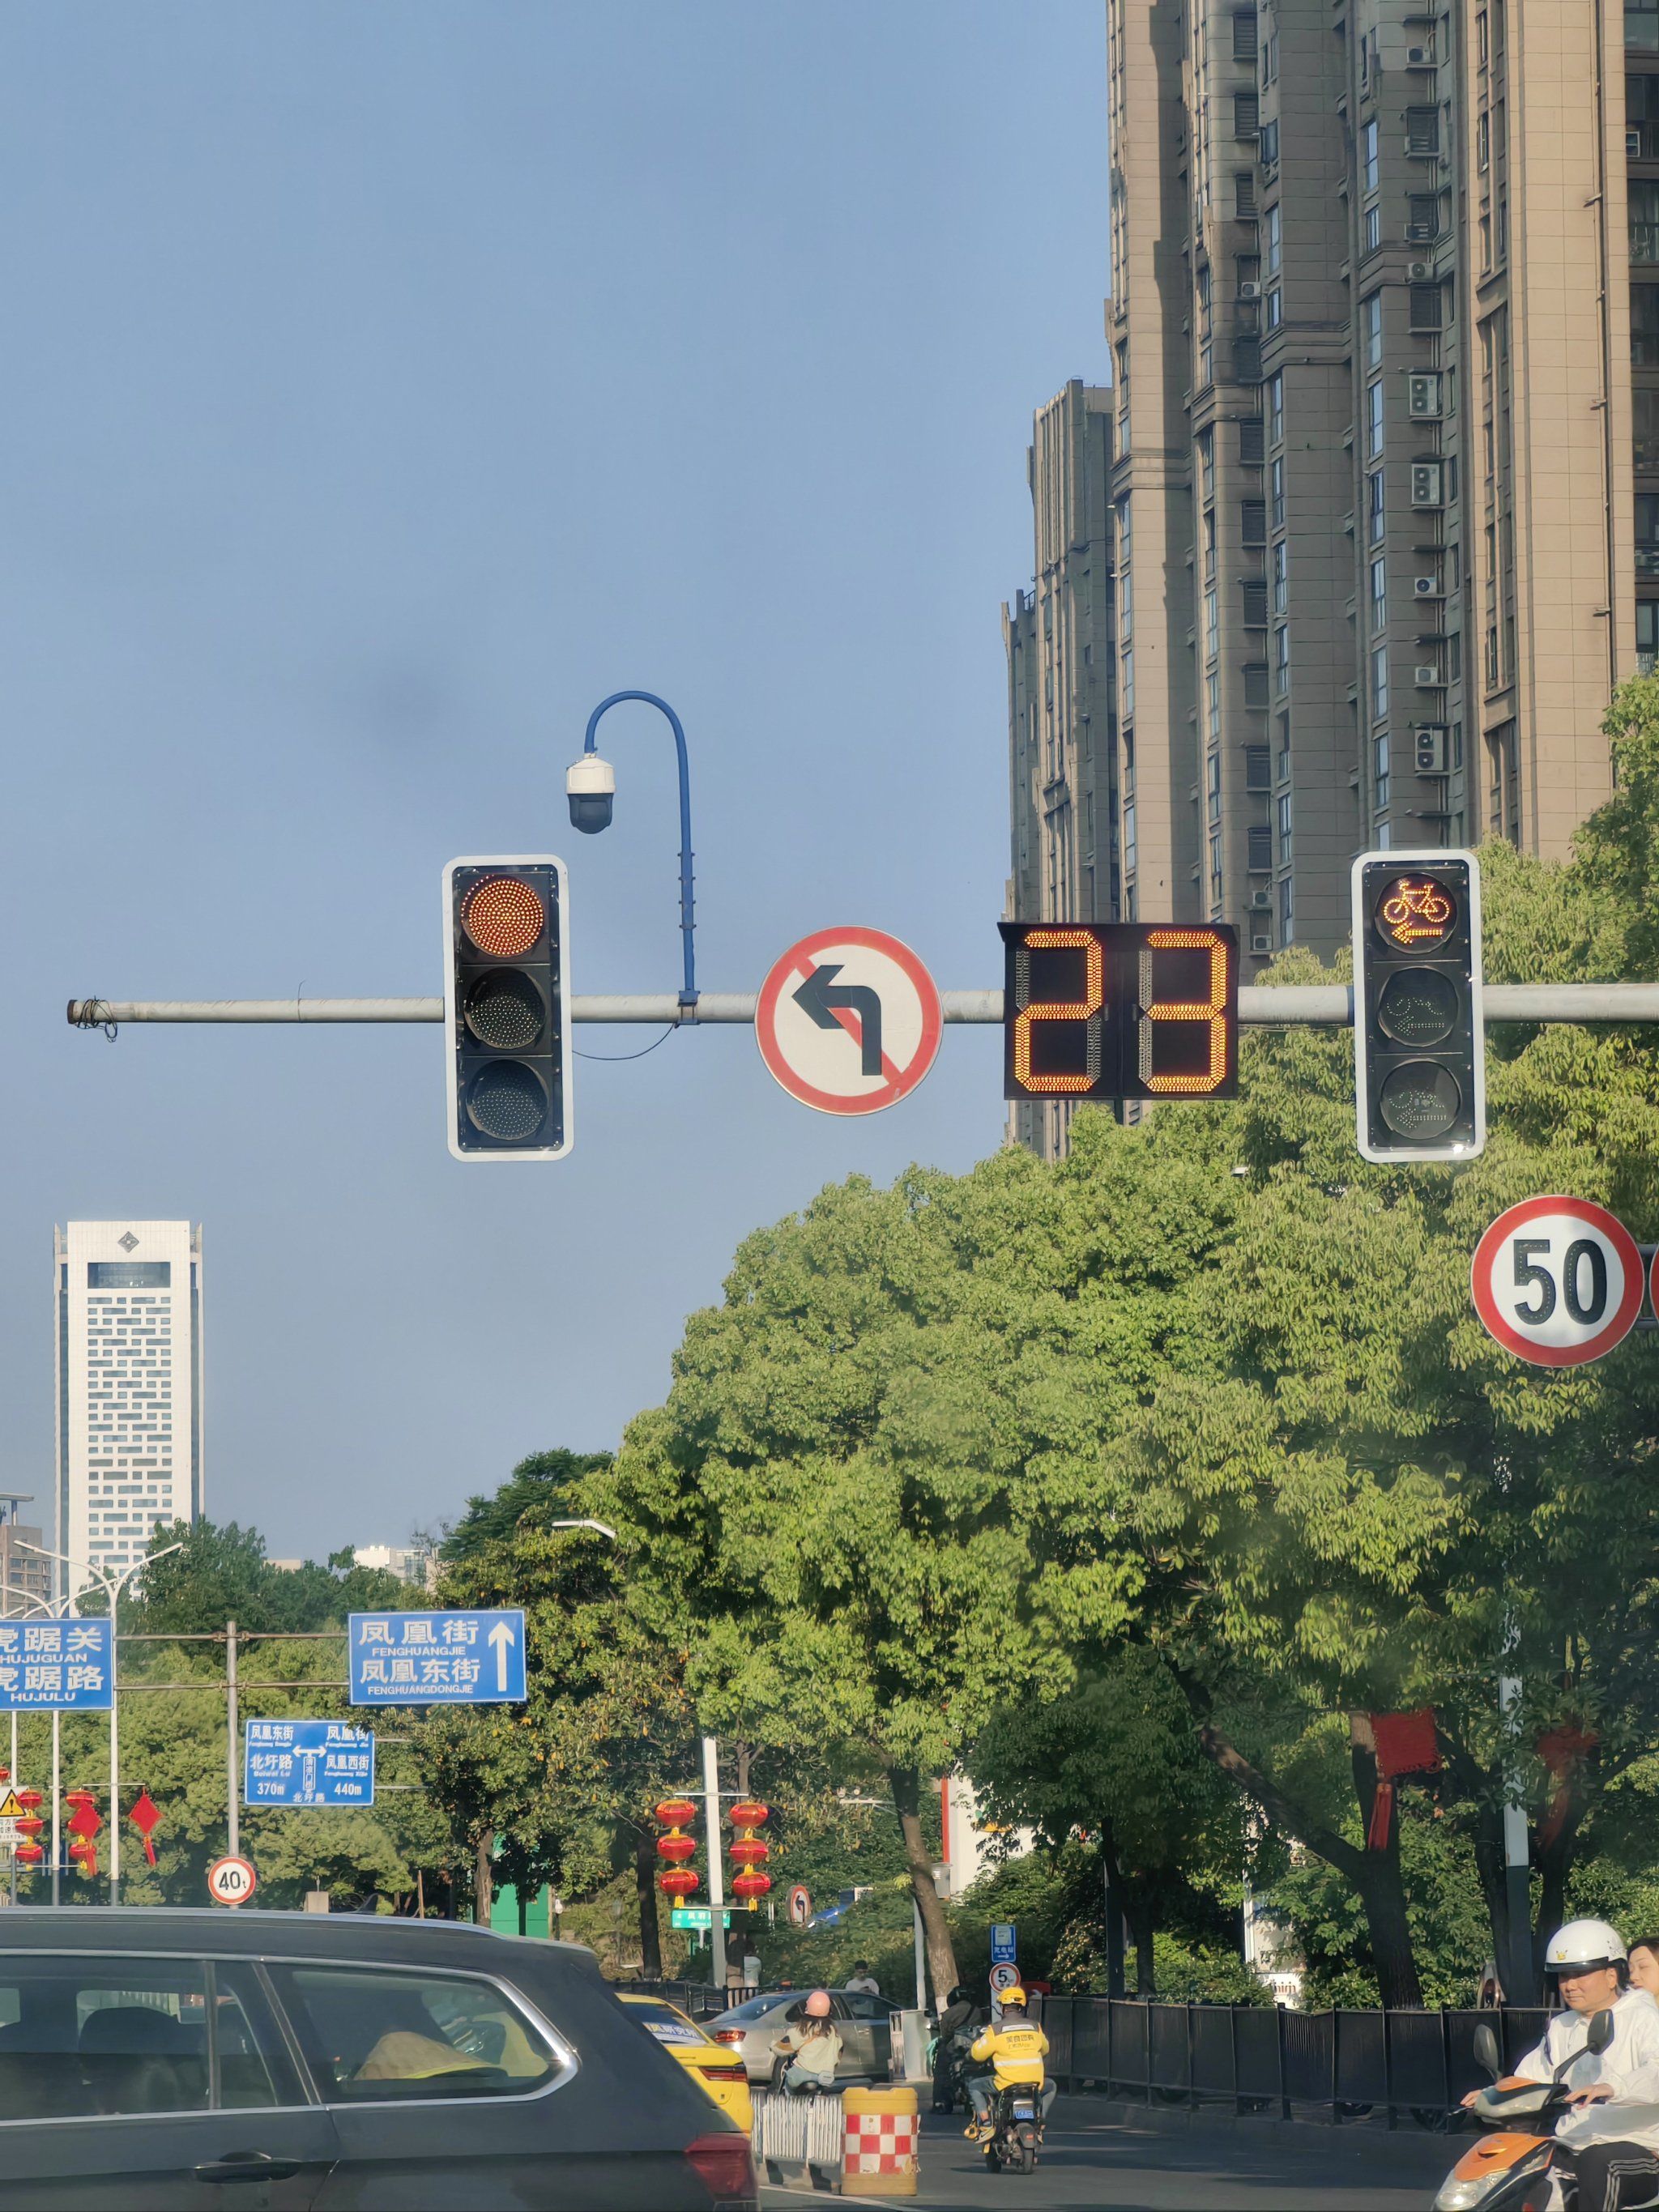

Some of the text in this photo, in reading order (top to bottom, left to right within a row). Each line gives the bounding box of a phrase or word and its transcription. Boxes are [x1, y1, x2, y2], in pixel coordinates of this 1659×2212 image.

[1014, 930, 1227, 1092] 23
[1513, 1239, 1607, 1326] 50
[359, 1620, 480, 1645] 凤凰街
[0, 1653, 87, 1664] HUJUGUAN
[372, 1646, 467, 1657] FENGHUANGJIE
[360, 1658, 480, 1684] 凤凰东街
[11, 1692, 76, 1702] HUJULU
[368, 1684, 474, 1695] FENGHUANGDONGJIE
[250, 1724, 294, 1741] 凤凰东街
[326, 1754, 370, 1771] 凤凰西街
[256, 1783, 285, 1796] 370m
[334, 1782, 362, 1796] 440m
